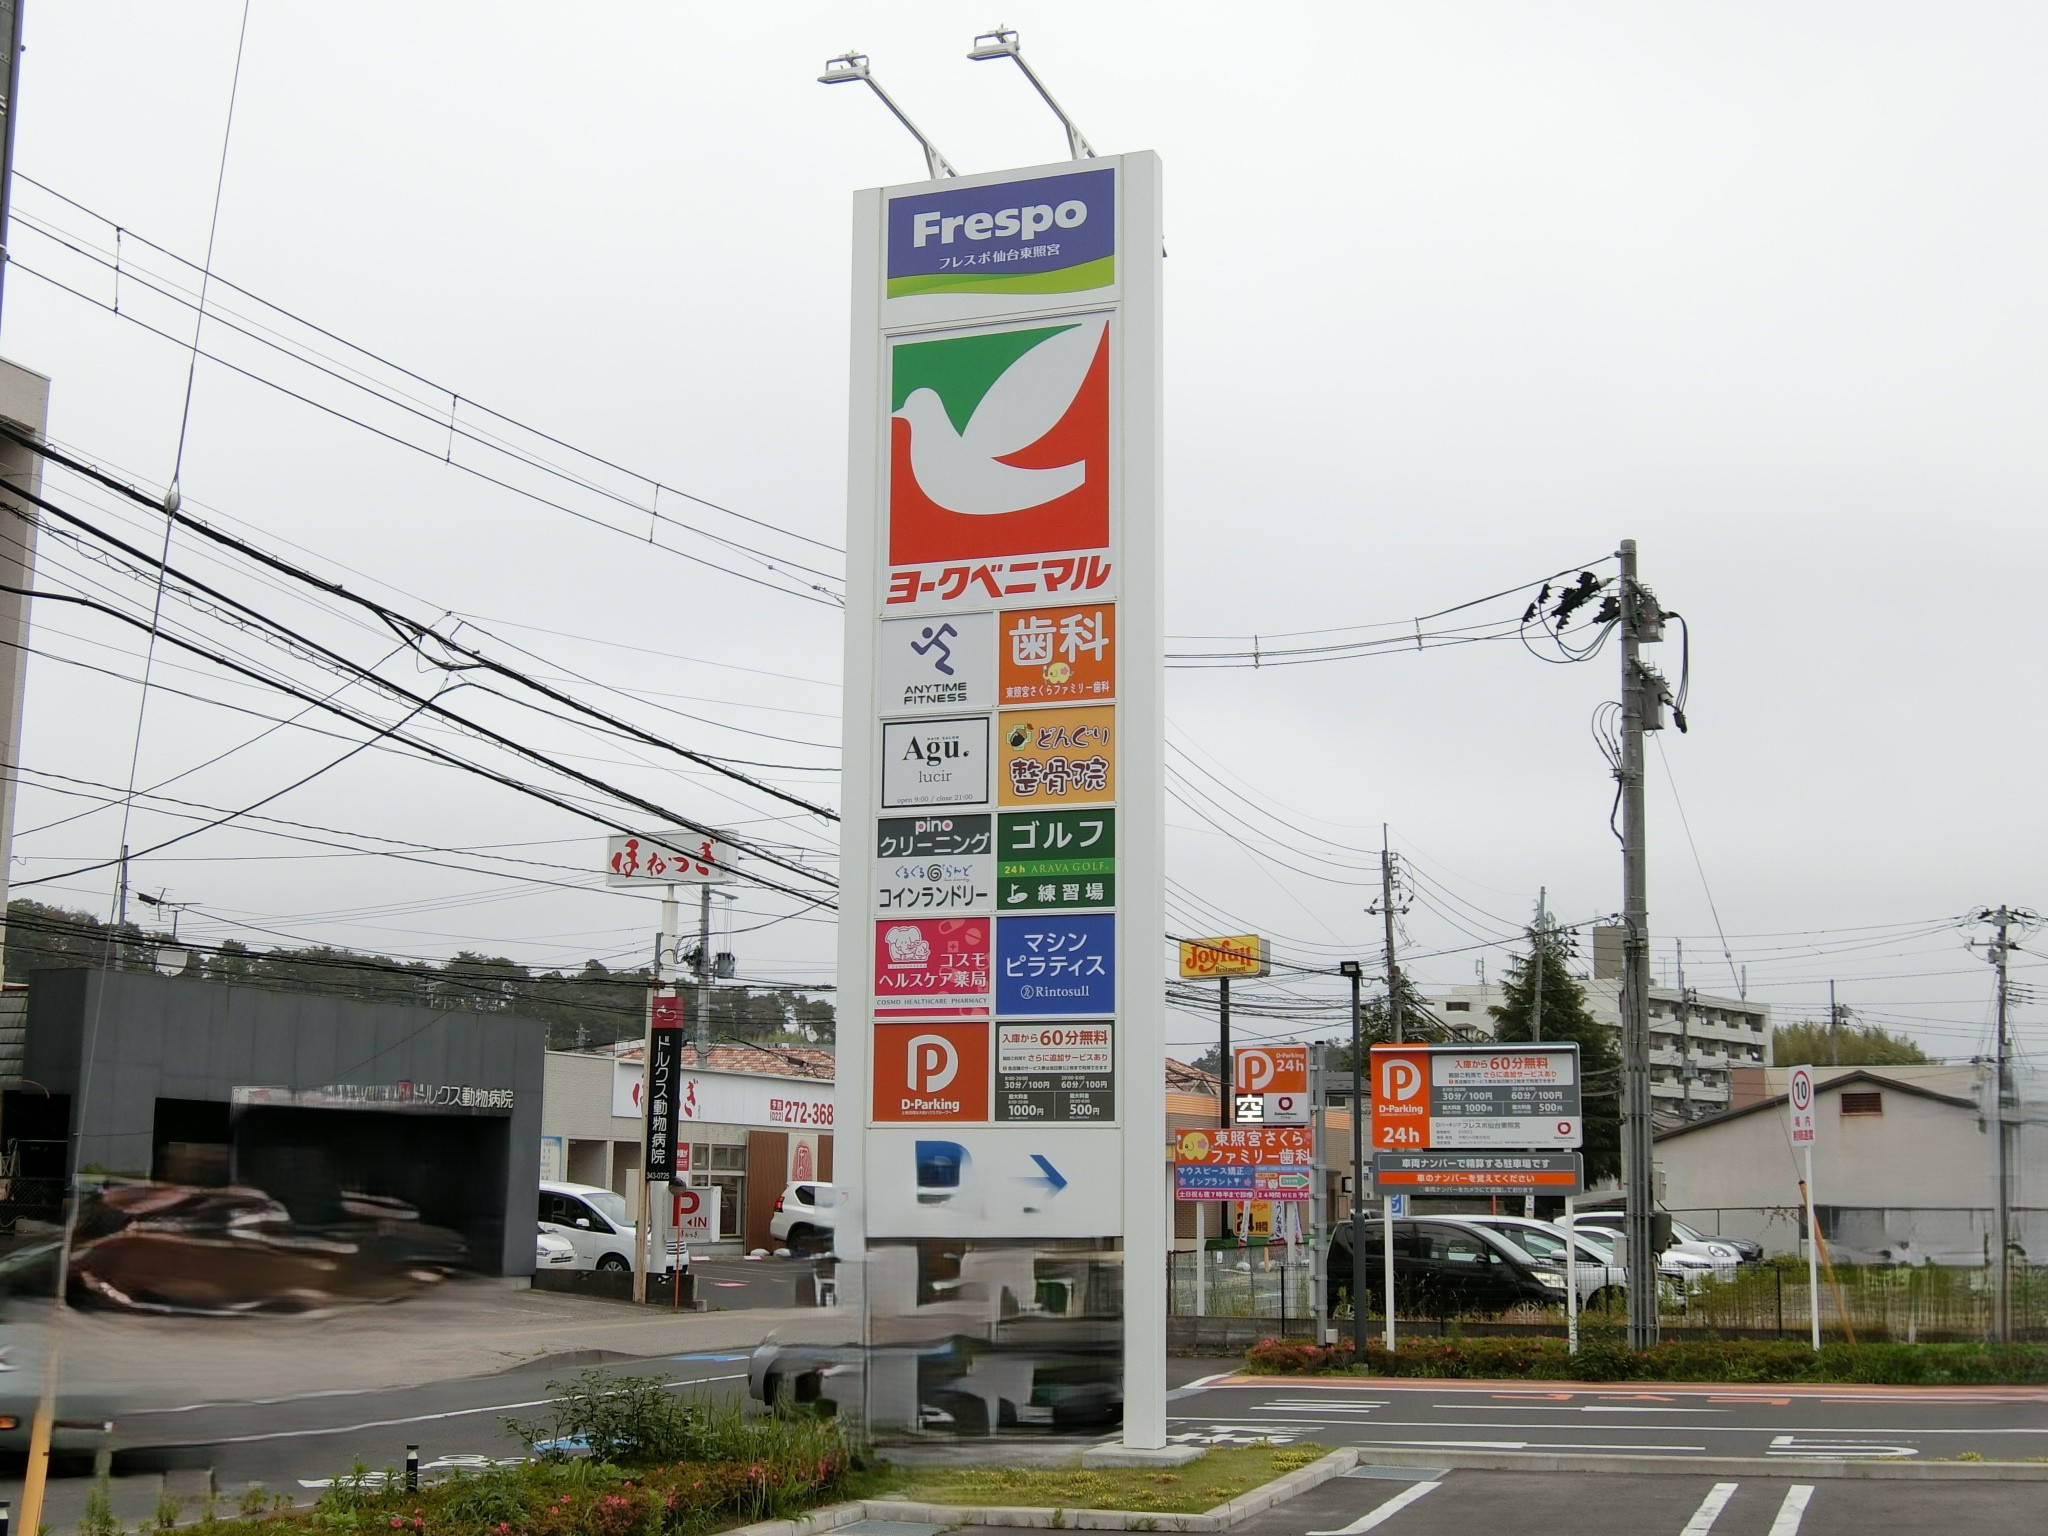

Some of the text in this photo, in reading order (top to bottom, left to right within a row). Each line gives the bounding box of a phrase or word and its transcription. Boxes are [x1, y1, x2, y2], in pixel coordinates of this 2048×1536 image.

[913, 199, 1088, 248] Frespo
[939, 243, 1061, 270] フレスポ仙台東照宮
[885, 555, 1112, 605] ヨークベニマル
[1009, 611, 1110, 666] 歯科
[904, 682, 967, 695] ANYTIME
[1005, 680, 1110, 699] 東照宮さくらファミリー歯科
[904, 692, 967, 705] FITNESS
[1036, 725, 1109, 750] どんぐり
[902, 736, 969, 767] Agu.
[918, 769, 953, 783] lucir
[1009, 755, 1109, 796] 整骨院
[897, 797, 913, 805] open
[954, 793, 973, 801] 21:00
[915, 817, 954, 835] pino
[1012, 820, 1104, 850] ゴルフ
[880, 832, 990, 857] クリーニング
[611, 838, 719, 878] ほねつぎ
[1004, 865, 1026, 875] 24h
[1031, 863, 1069, 873] ARAVA
[879, 885, 988, 908] コインランドリー
[1037, 882, 1105, 903] 練習場
[1024, 932, 1088, 953] マシン
[940, 952, 986, 967] コスモ
[1185, 940, 1252, 973] Joyfull
[1006, 954, 1106, 978] ピラティス
[1215, 965, 1247, 973] Restaurant
[878, 971, 986, 988] ヘルスケア薬局
[1035, 985, 1090, 997] Rintosull
[1002, 1029, 1109, 1046] 入庫から60分無料
[1028, 1053, 1108, 1062] さらに追加サービスあり
[1276, 1059, 1305, 1072] 24h
[1454, 1056, 1549, 1070] 入庫から60分無料
[1483, 1070, 1557, 1078] さらに追加サービスあり
[1795, 1081, 1807, 1100] 10
[650, 1034, 671, 1165] ドルクス動物病院
[1236, 1093, 1264, 1123] 空
[1465, 1103, 1493, 1112] 1000円
[1539, 1103, 1563, 1112] 500円
[1008, 1104, 1044, 1116] 1000円
[1069, 1104, 1100, 1115] 500円
[1214, 1130, 1304, 1147] 東照宮さくら
[1383, 1126, 1420, 1144] 24h
[1211, 1148, 1310, 1165] ファミリー歯科
[1401, 1158, 1551, 1169] 車両ナンバーで精算する駐車場です
[1177, 1166, 1245, 1176] マウスピース矯正
[1416, 1173, 1536, 1183] 車のナンバーを覚えてください
[1189, 1177, 1233, 1187] インプラント
[671, 1191, 701, 1227] P
[694, 1216, 708, 1228] IN
